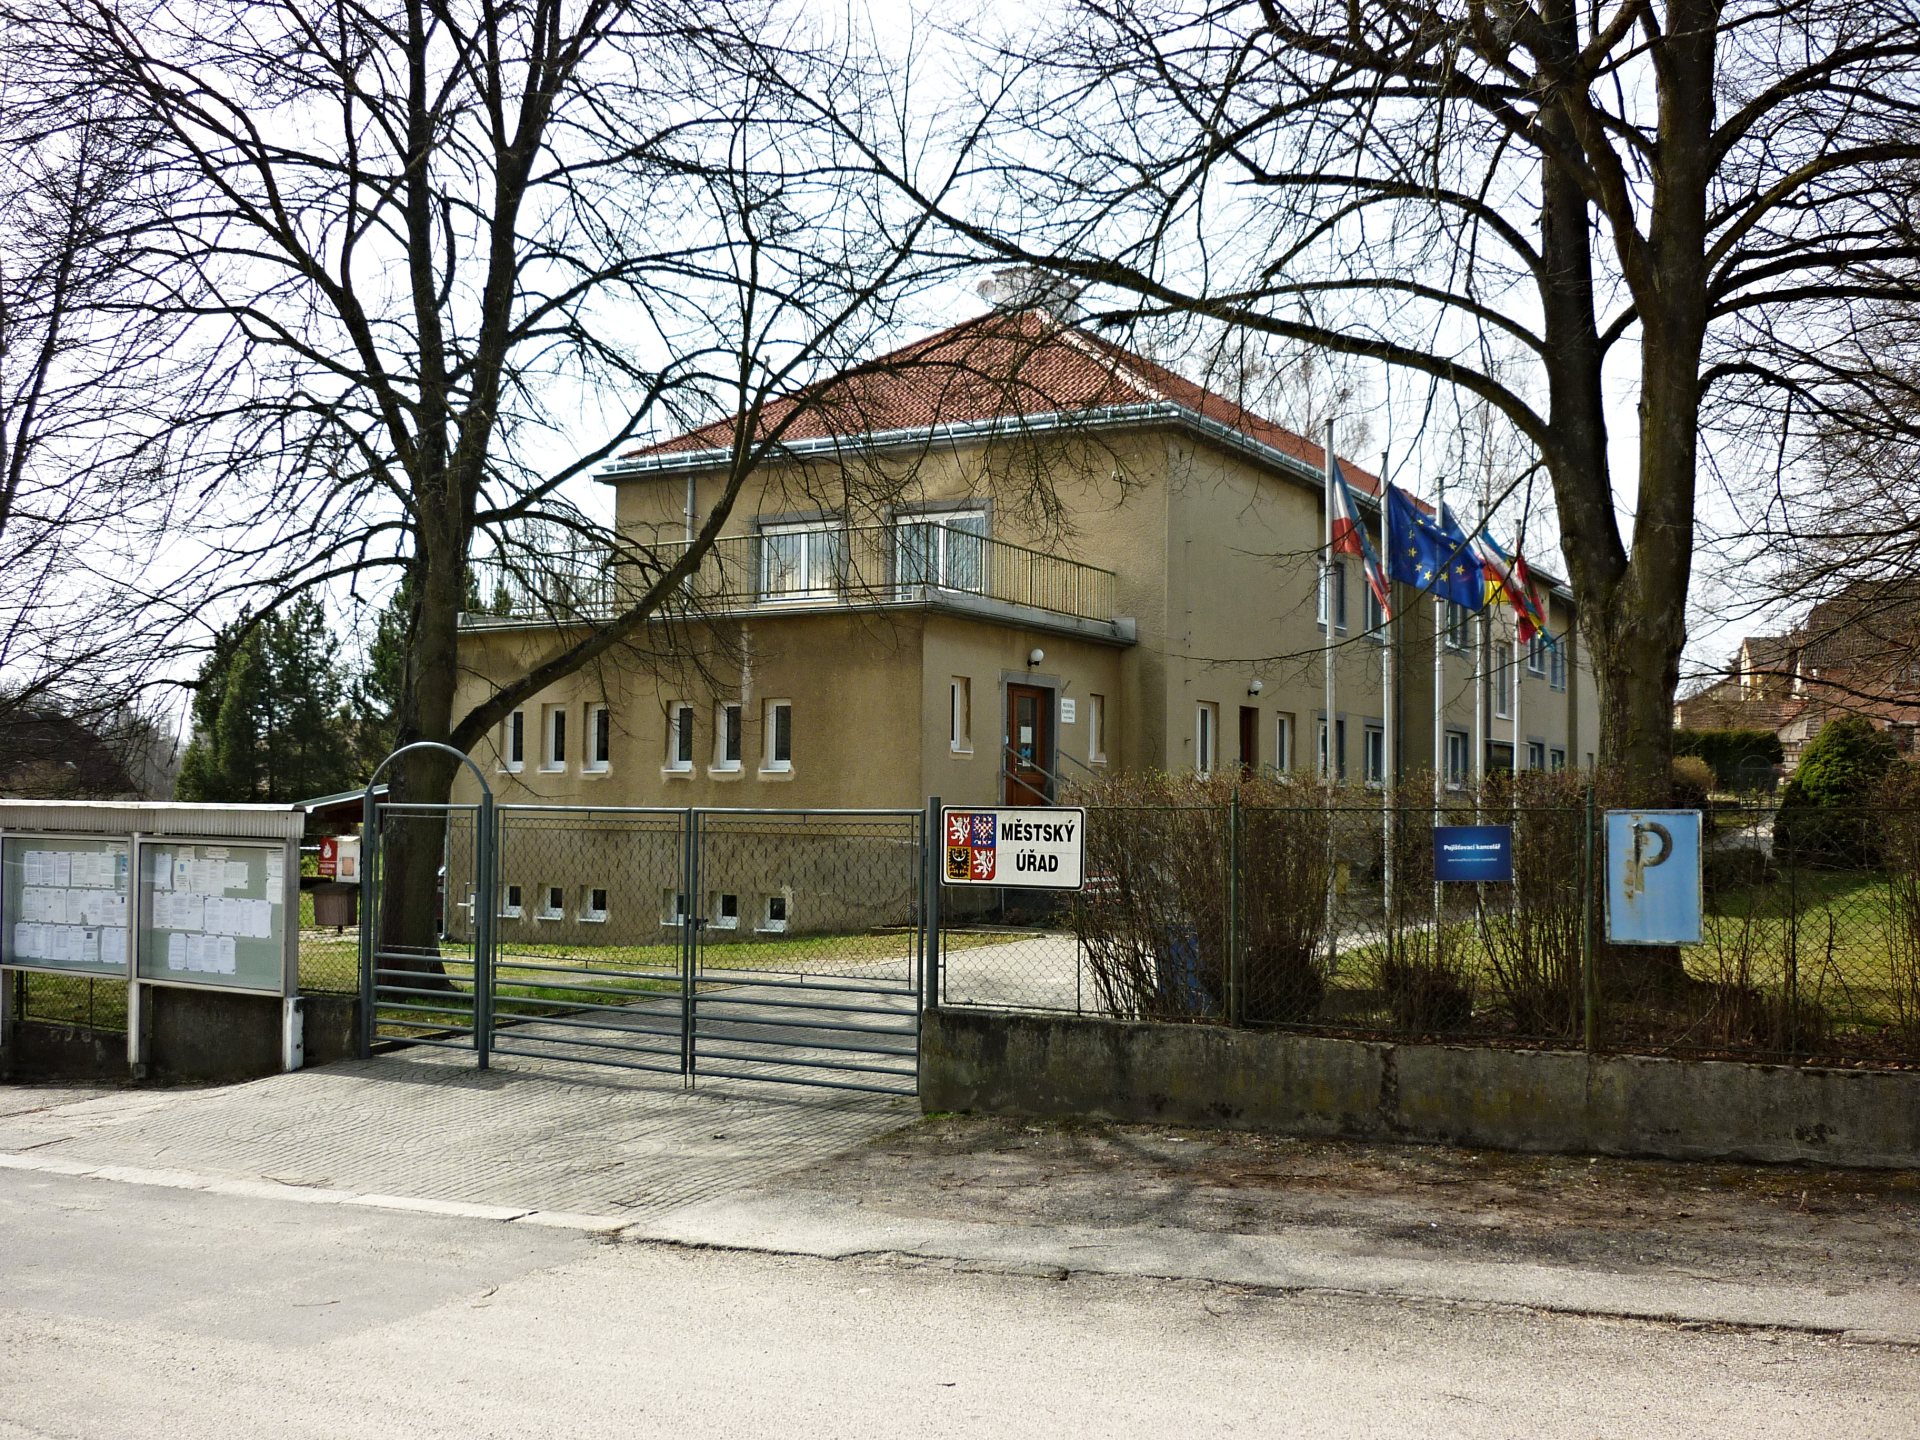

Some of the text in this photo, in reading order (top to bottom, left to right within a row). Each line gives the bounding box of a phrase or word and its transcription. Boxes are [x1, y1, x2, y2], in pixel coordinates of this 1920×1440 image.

[1001, 818, 1075, 842] MĚSTSKÝ
[1476, 842, 1501, 850] kancelář
[1633, 822, 1673, 894] P
[1016, 848, 1059, 872] ÚŘAD
